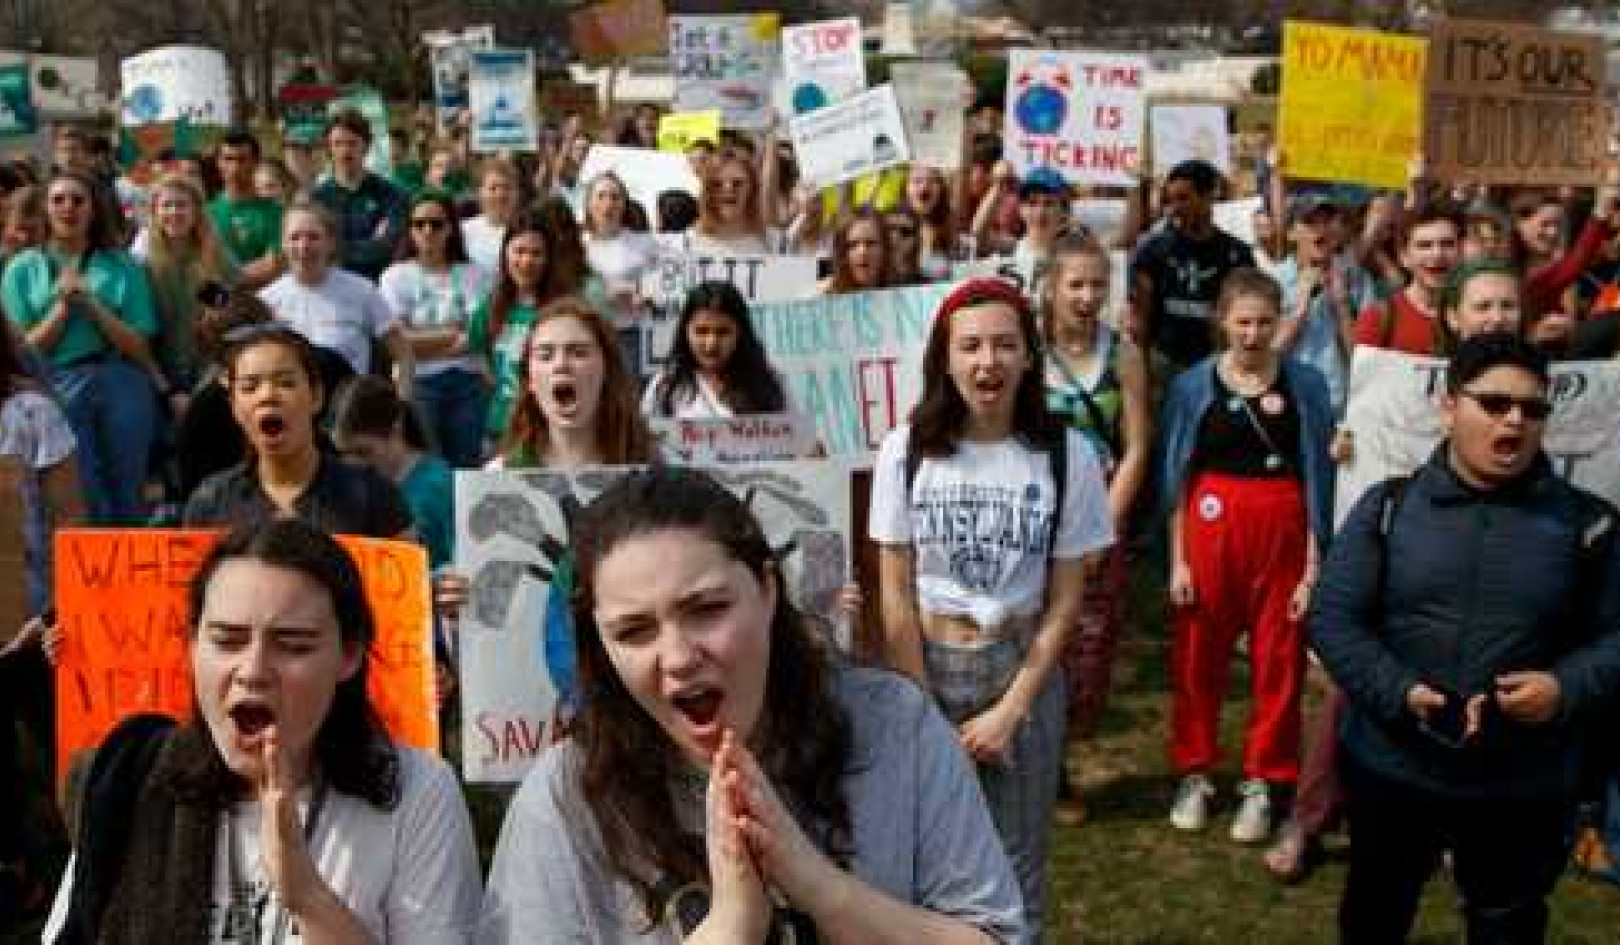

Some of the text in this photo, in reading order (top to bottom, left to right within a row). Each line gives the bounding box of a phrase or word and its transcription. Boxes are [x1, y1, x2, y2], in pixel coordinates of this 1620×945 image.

[791, 25, 853, 54] STOP
[1082, 65, 1141, 88] TIME
[1443, 35, 1596, 92] IT'S OUR
[1095, 105, 1123, 131] IS
[71, 536, 200, 589] WHE
